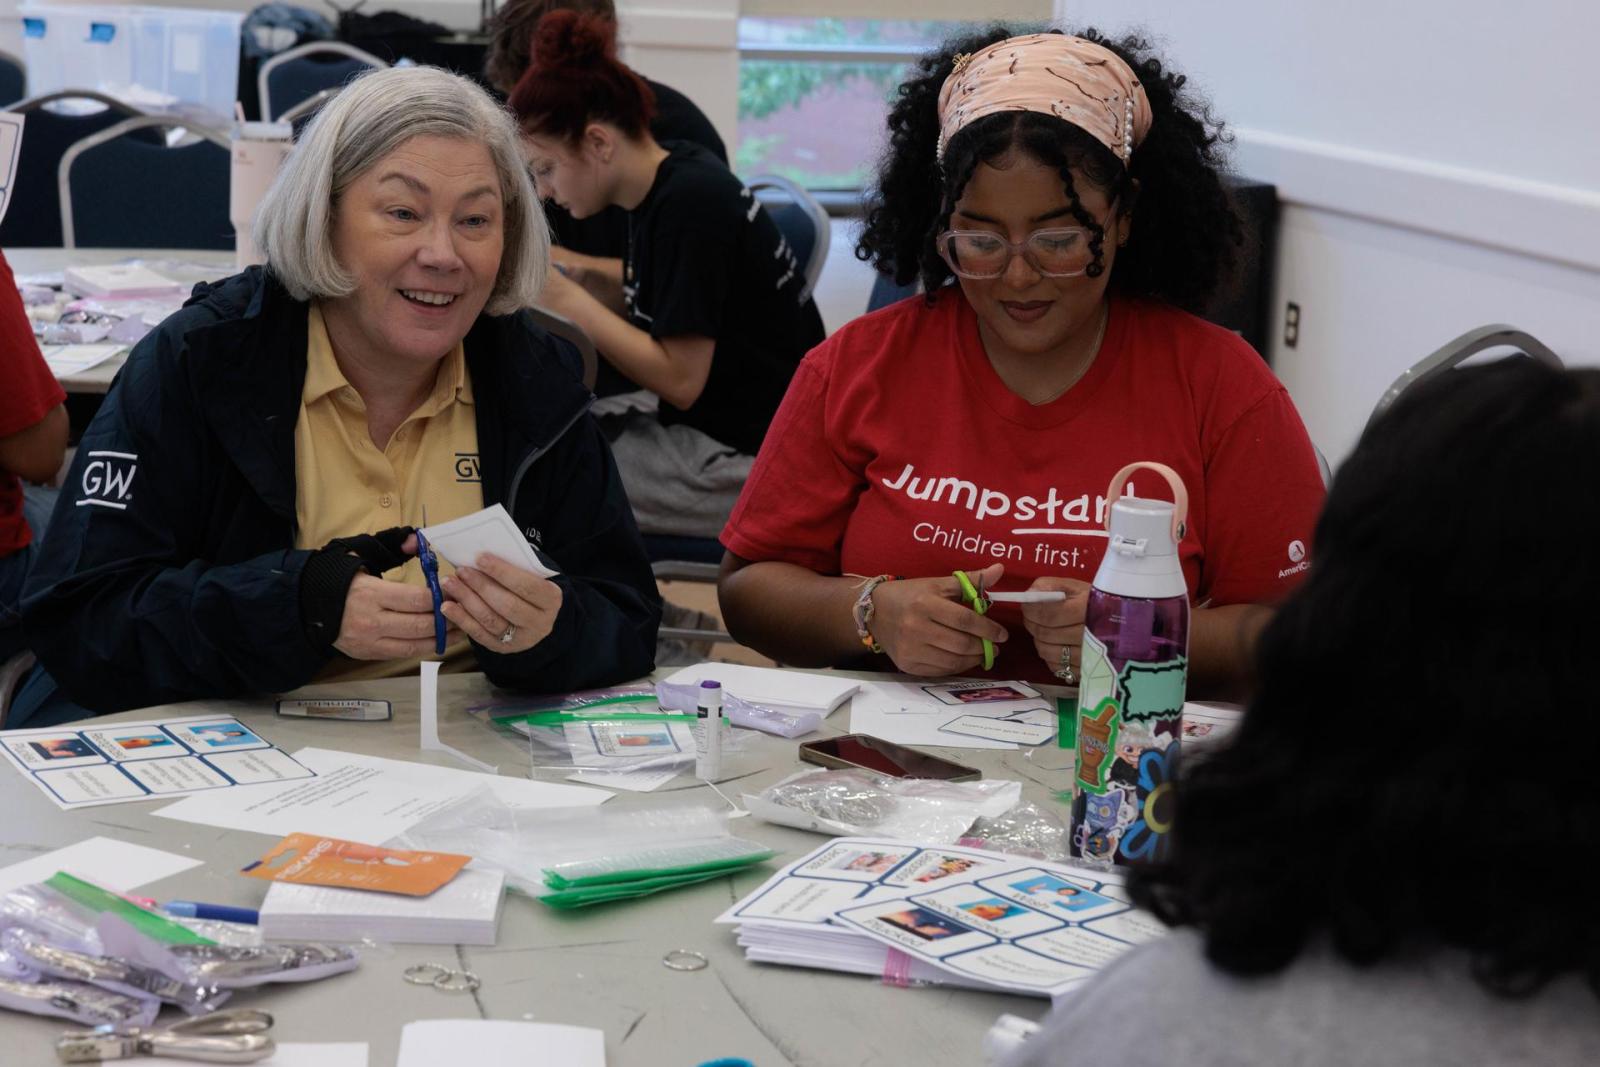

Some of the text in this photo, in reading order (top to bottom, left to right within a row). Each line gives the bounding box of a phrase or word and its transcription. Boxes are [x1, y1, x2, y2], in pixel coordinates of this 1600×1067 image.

[82, 461, 136, 499] GW
[913, 522, 1086, 569] Children first.
